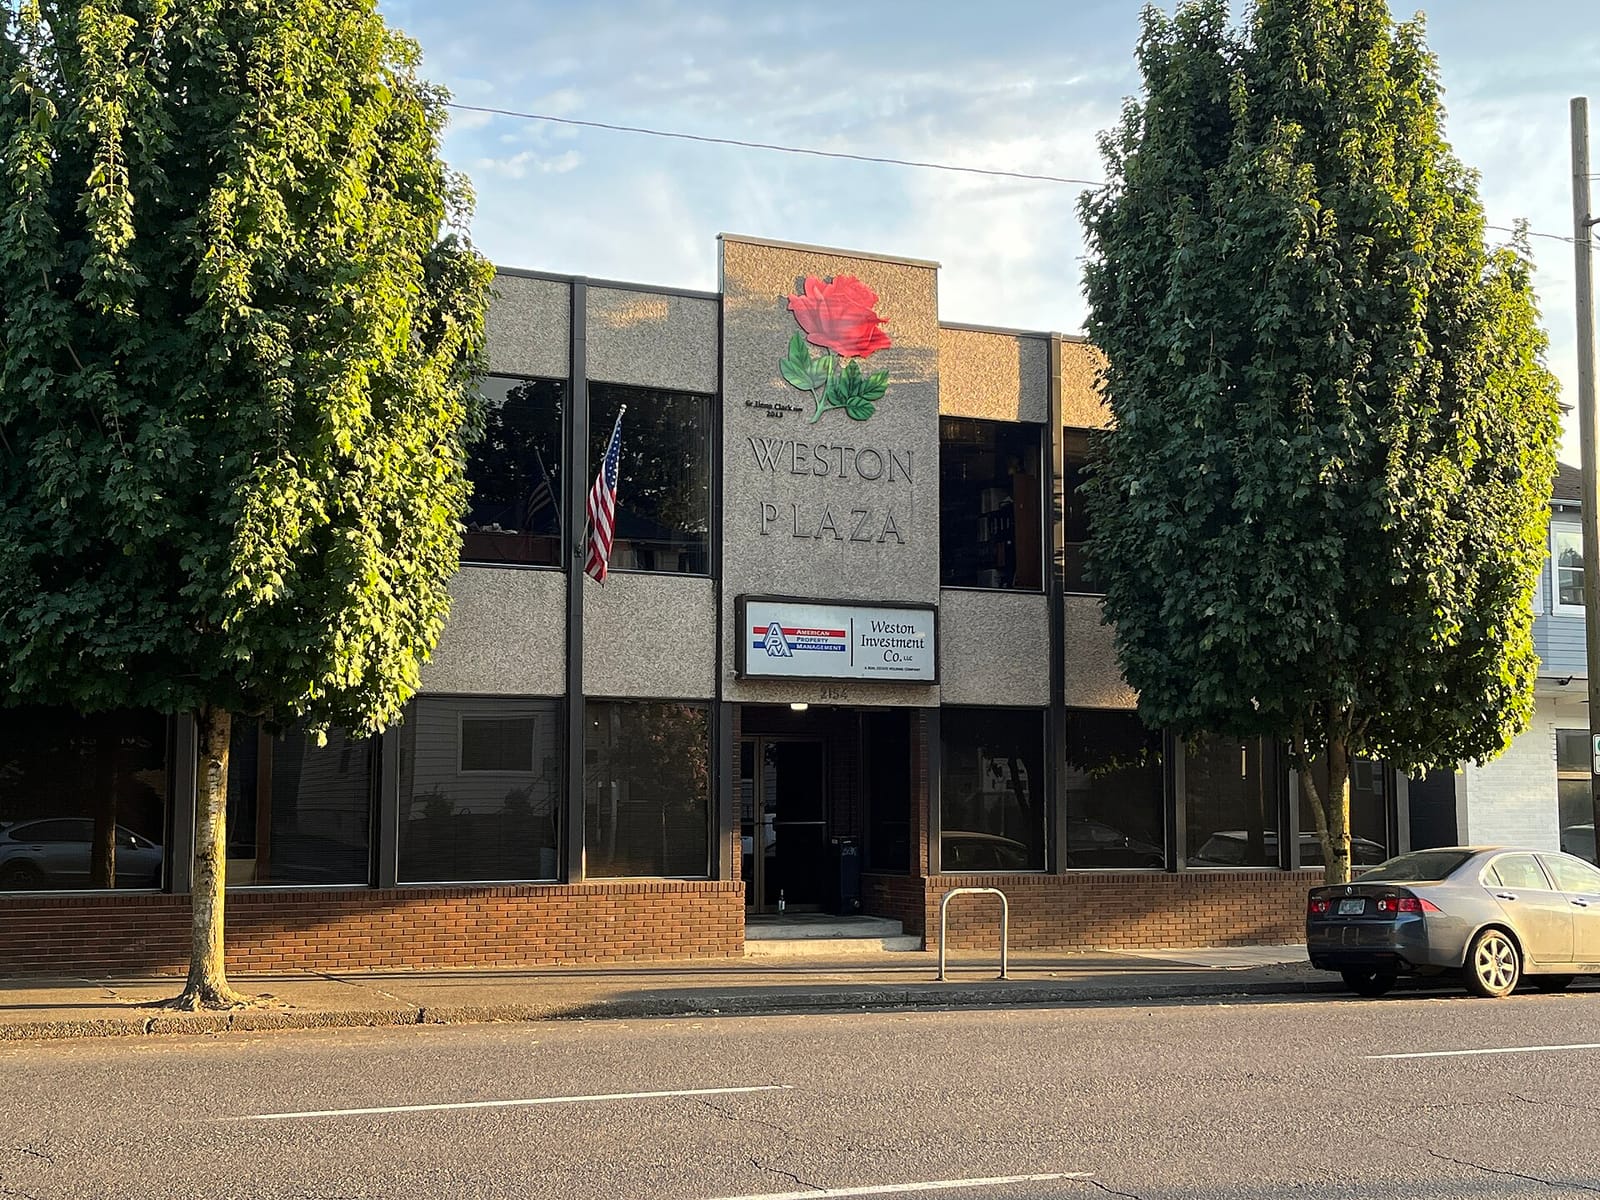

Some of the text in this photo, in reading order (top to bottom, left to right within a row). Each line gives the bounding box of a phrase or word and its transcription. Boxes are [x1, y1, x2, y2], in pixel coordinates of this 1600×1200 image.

[748, 437, 914, 485] WESTON
[760, 501, 905, 545] PLAZA
[796, 629, 830, 637] AMERICAN
[871, 620, 915, 634] Weston
[796, 643, 842, 651] MANAGEMENT
[860, 634, 925, 649] Investment
[883, 649, 902, 663] Co.
